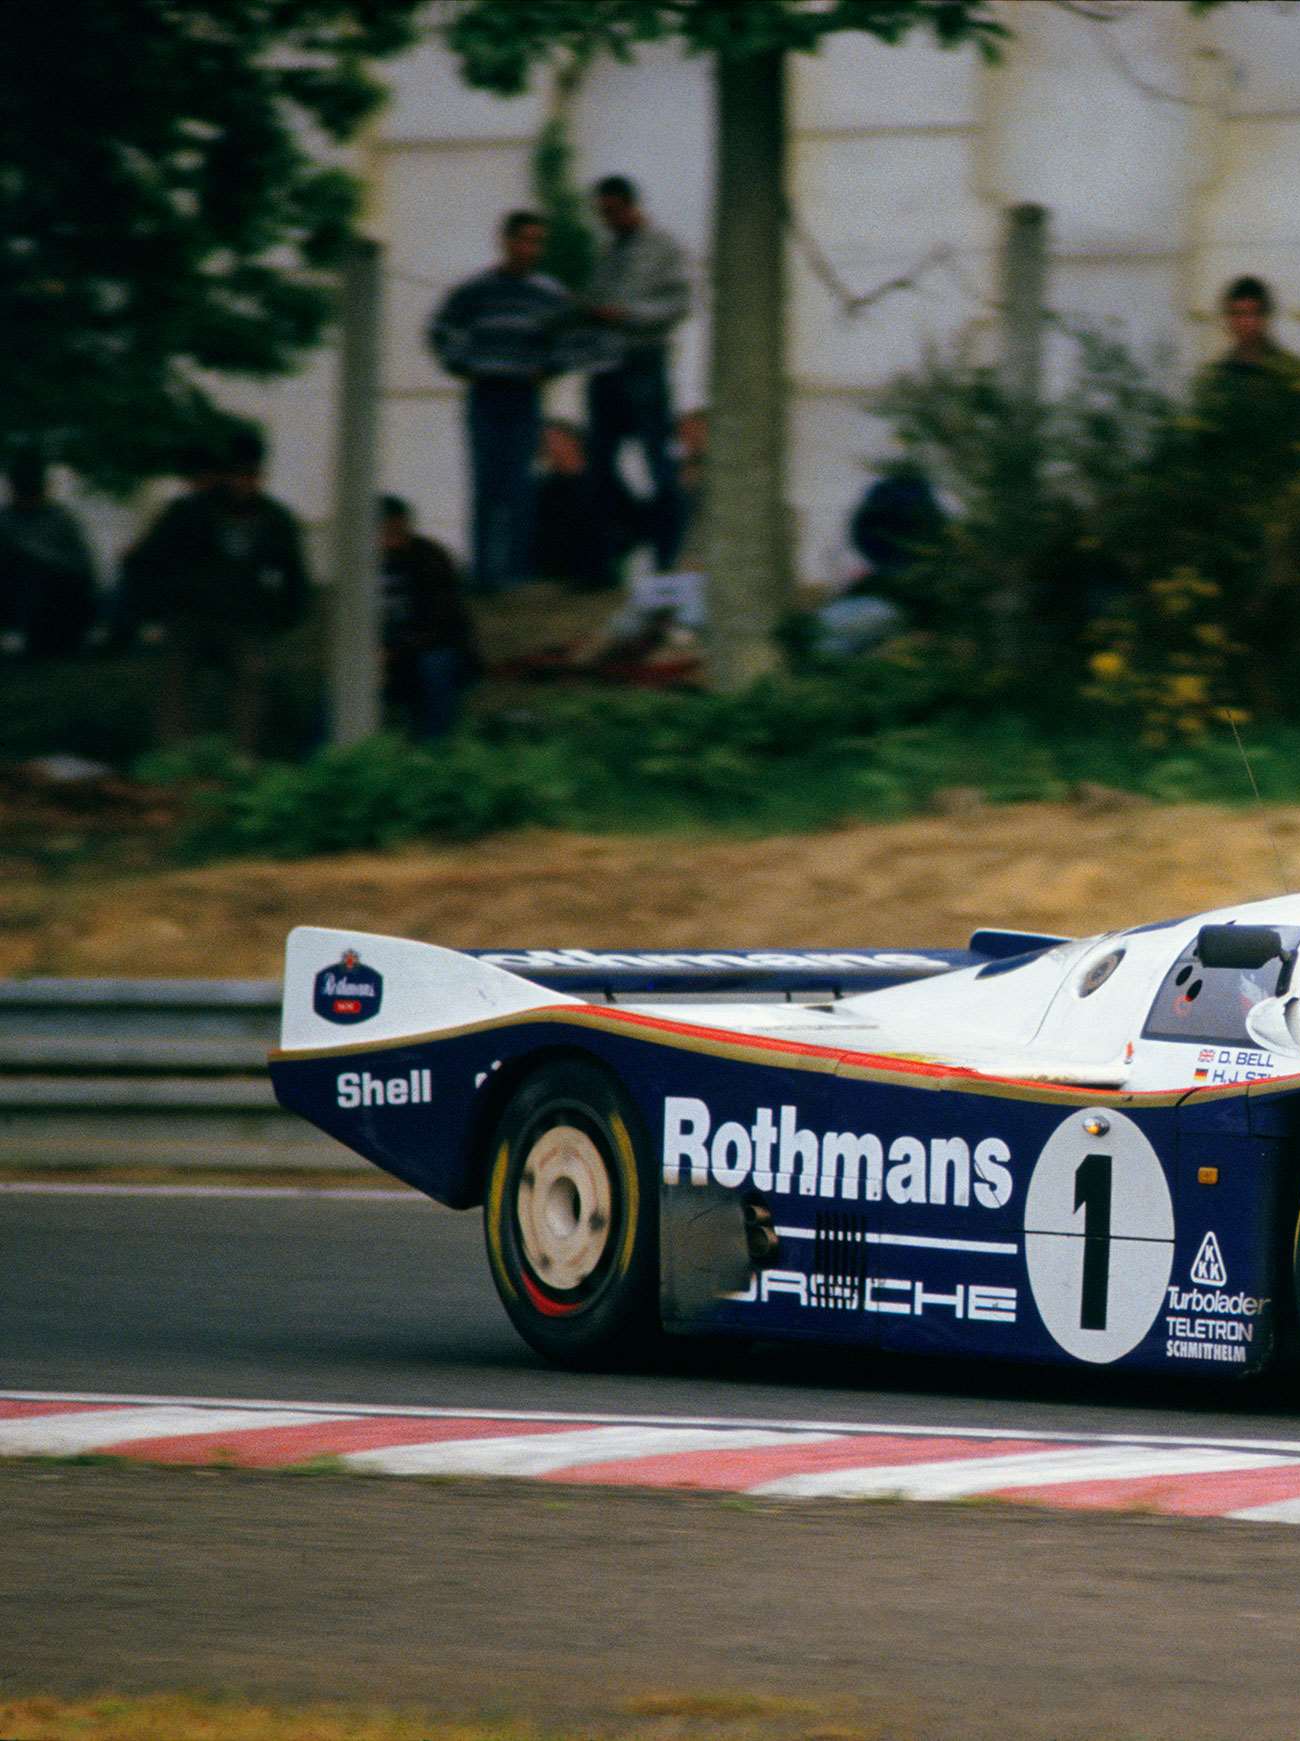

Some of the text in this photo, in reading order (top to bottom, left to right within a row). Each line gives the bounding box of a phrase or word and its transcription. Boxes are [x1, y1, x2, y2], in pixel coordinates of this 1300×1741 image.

[1235, 1052, 1274, 1068] BELL
[337, 1069, 431, 1108] Shell
[663, 1096, 1013, 1209] Rothmans
[1073, 1154, 1112, 1330] 1
[1167, 1286, 1272, 1316] Turbolader
[1166, 1316, 1253, 1342] TELETRON
